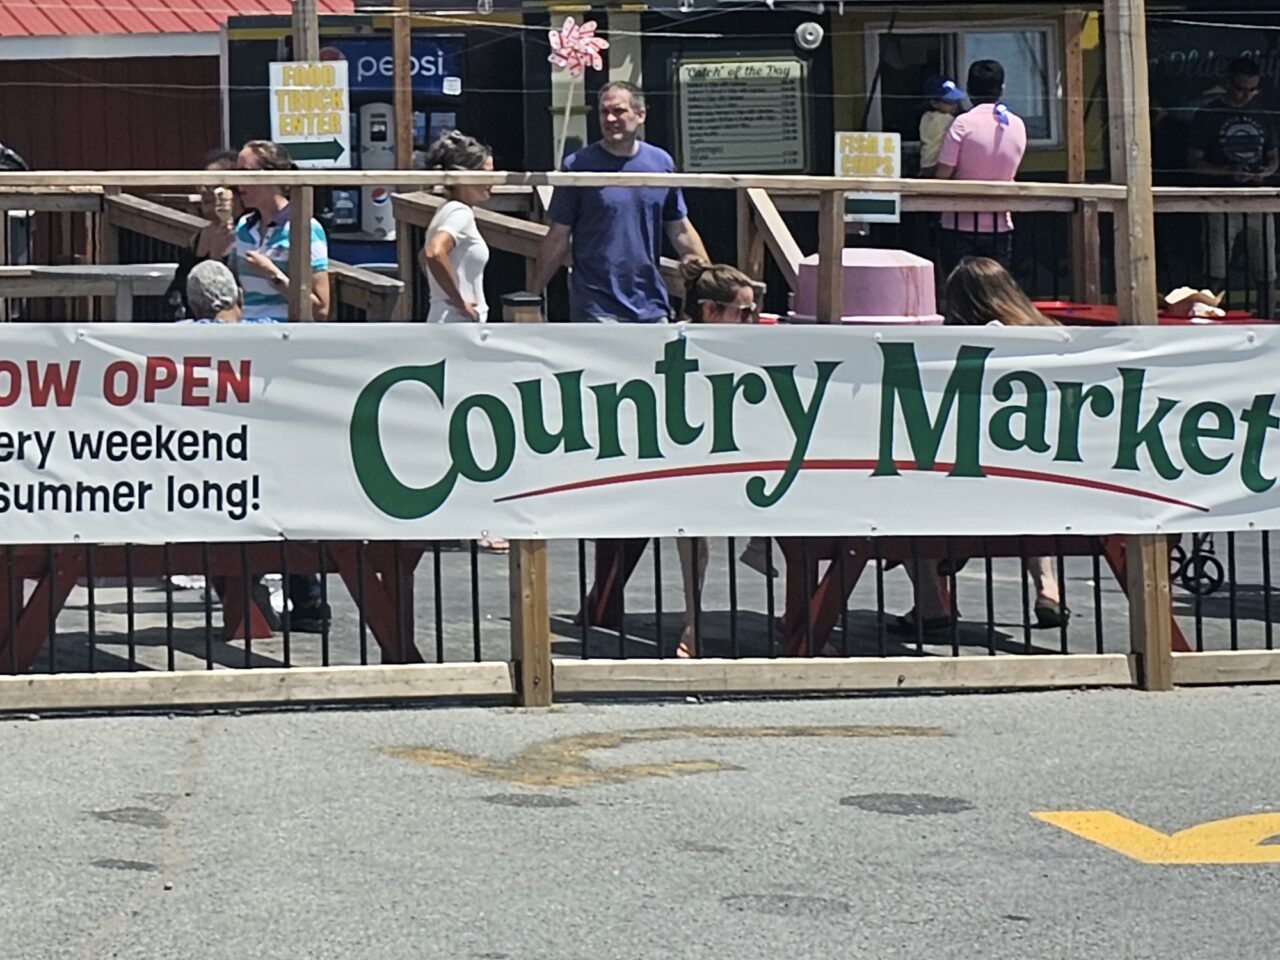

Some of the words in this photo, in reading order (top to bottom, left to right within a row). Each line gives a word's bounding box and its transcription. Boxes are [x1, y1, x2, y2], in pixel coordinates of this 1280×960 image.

[282, 64, 336, 87] FOOD
[274, 88, 345, 113] TRUCK
[278, 112, 341, 137] ENTER
[103, 356, 252, 407] OPEN
[68, 424, 248, 462] weekend
[350, 338, 843, 520] Country
[871, 341, 1280, 493] Market
[167, 474, 261, 520] long!
